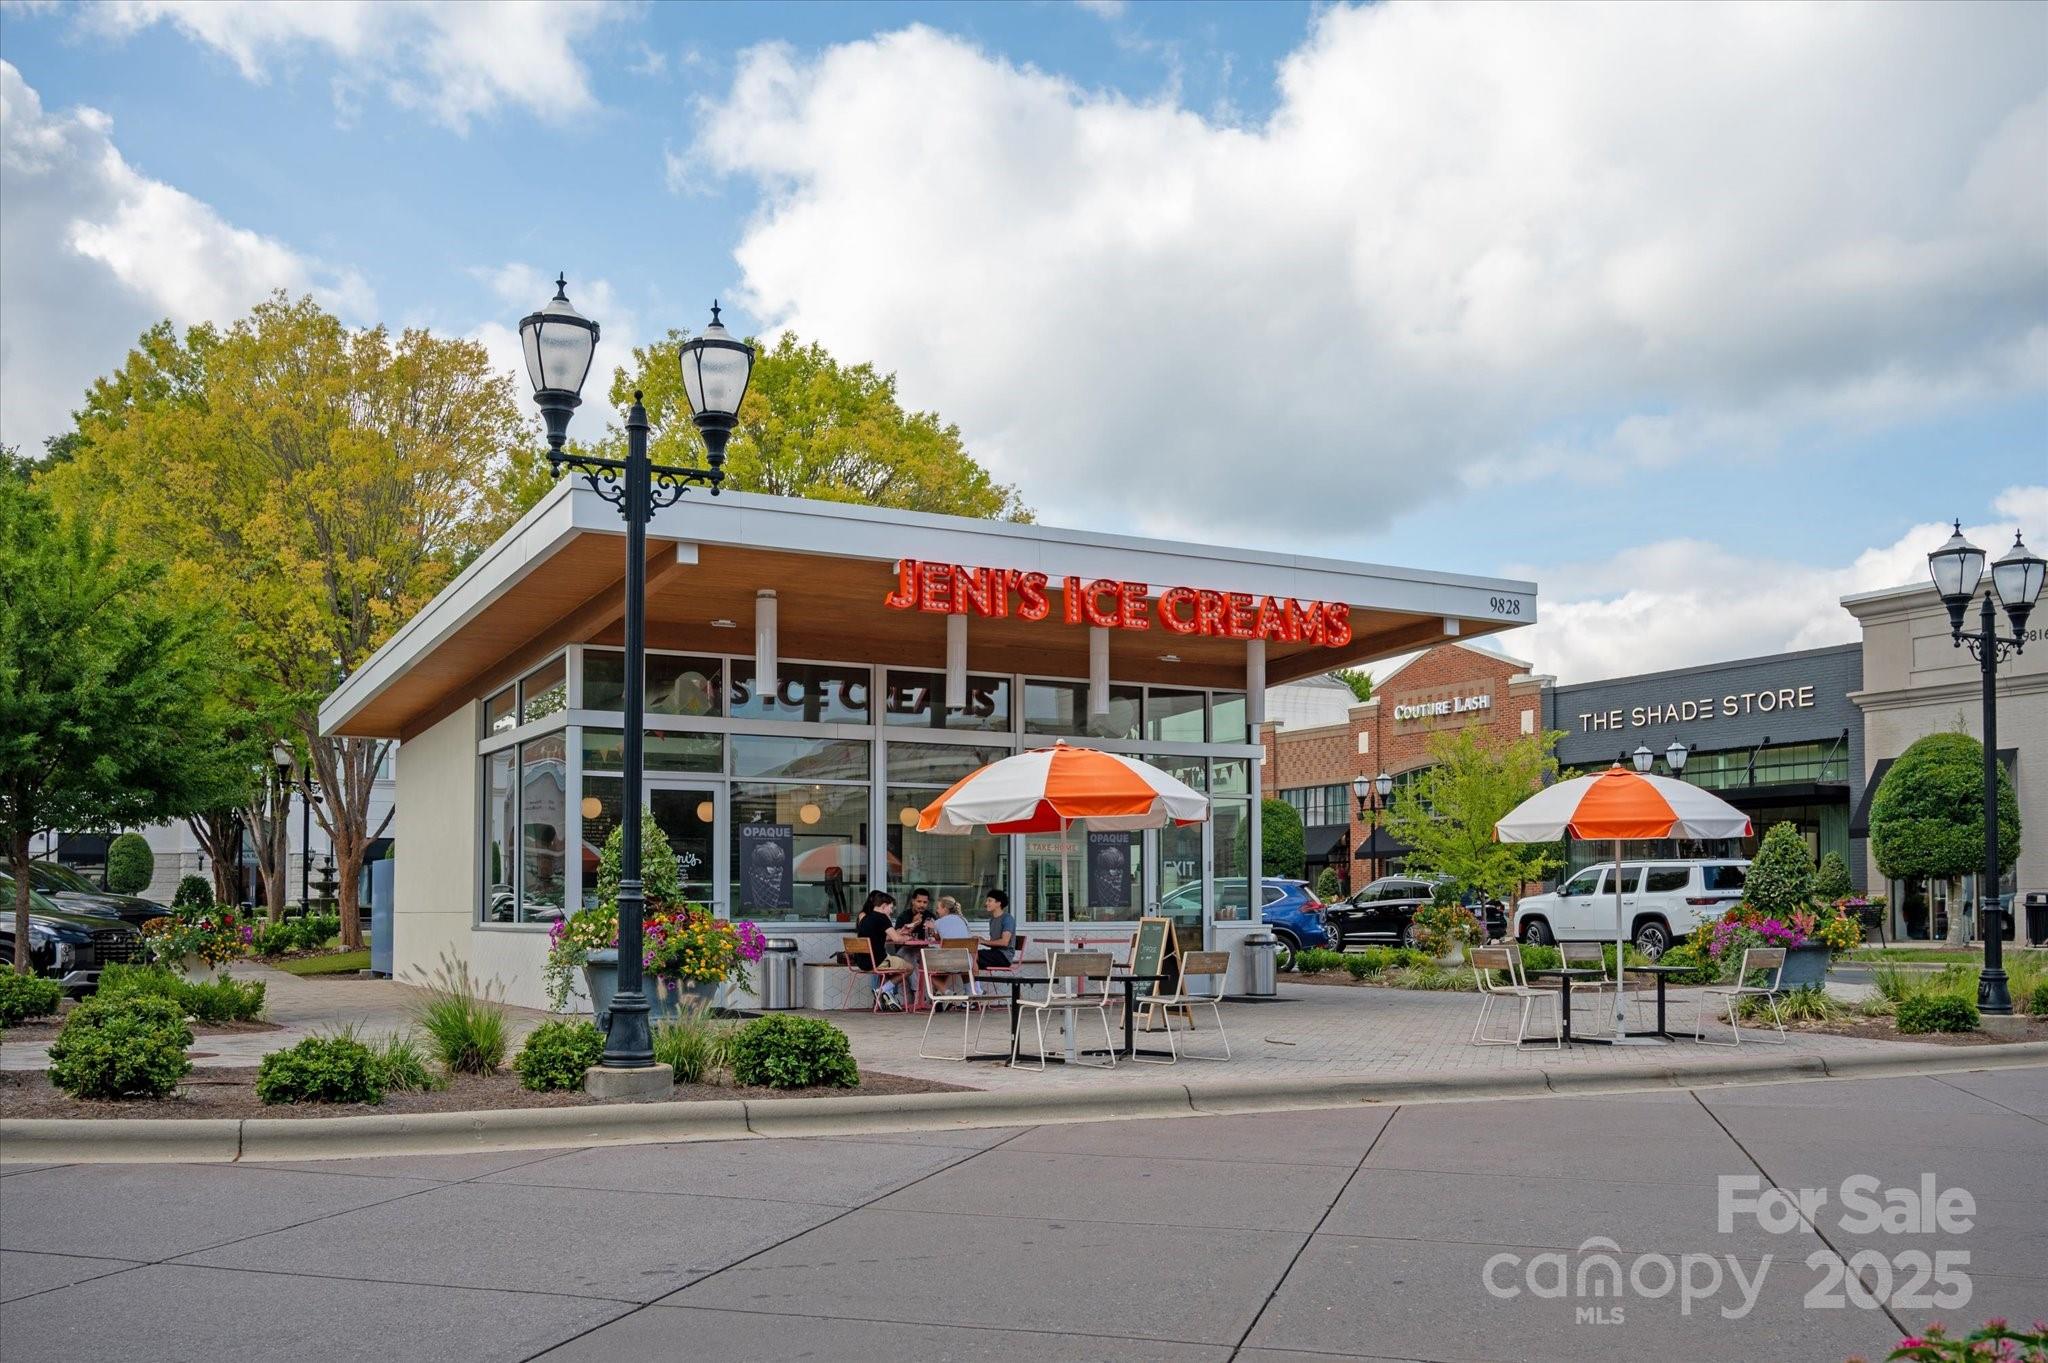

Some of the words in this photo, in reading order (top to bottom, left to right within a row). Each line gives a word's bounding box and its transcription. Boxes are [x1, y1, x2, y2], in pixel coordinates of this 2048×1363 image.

[885, 559, 1050, 620] JENI'S
[1063, 577, 1150, 629] ICE
[1158, 586, 1351, 648] CREAMS
[1490, 597, 1520, 614] 9828
[1453, 694, 1490, 713] LASH
[1579, 711, 1622, 732] THE
[1631, 698, 1715, 727] SHADE
[1722, 685, 1815, 716] STORE
[743, 827, 790, 838] OPAQUE
[1090, 833, 1129, 843] OPAQUE
[1164, 861, 1195, 877] EXIT
